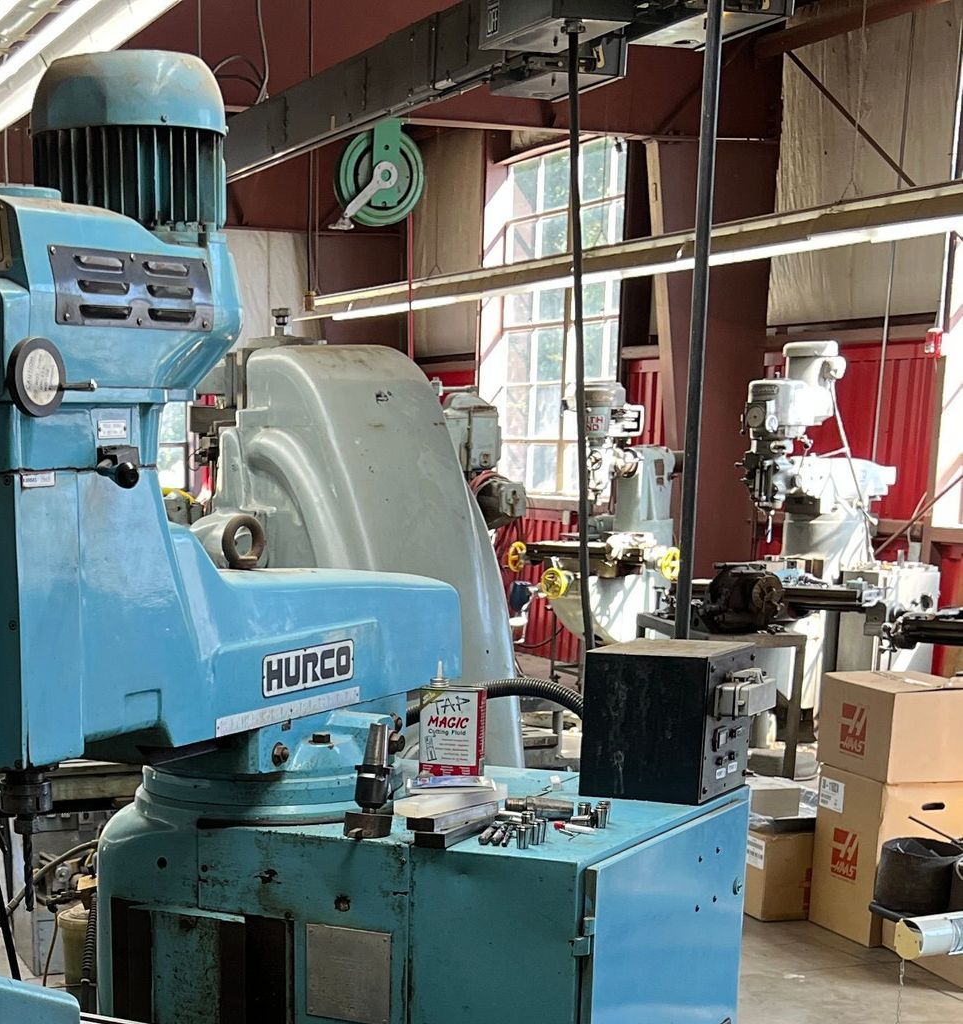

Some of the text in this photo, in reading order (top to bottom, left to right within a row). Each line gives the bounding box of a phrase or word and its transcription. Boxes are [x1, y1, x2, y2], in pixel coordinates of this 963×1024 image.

[266, 646, 351, 692] HURCO
[434, 695, 471, 715] TAP
[427, 715, 470, 729] MAGIC
[428, 728, 449, 737] Cutting
